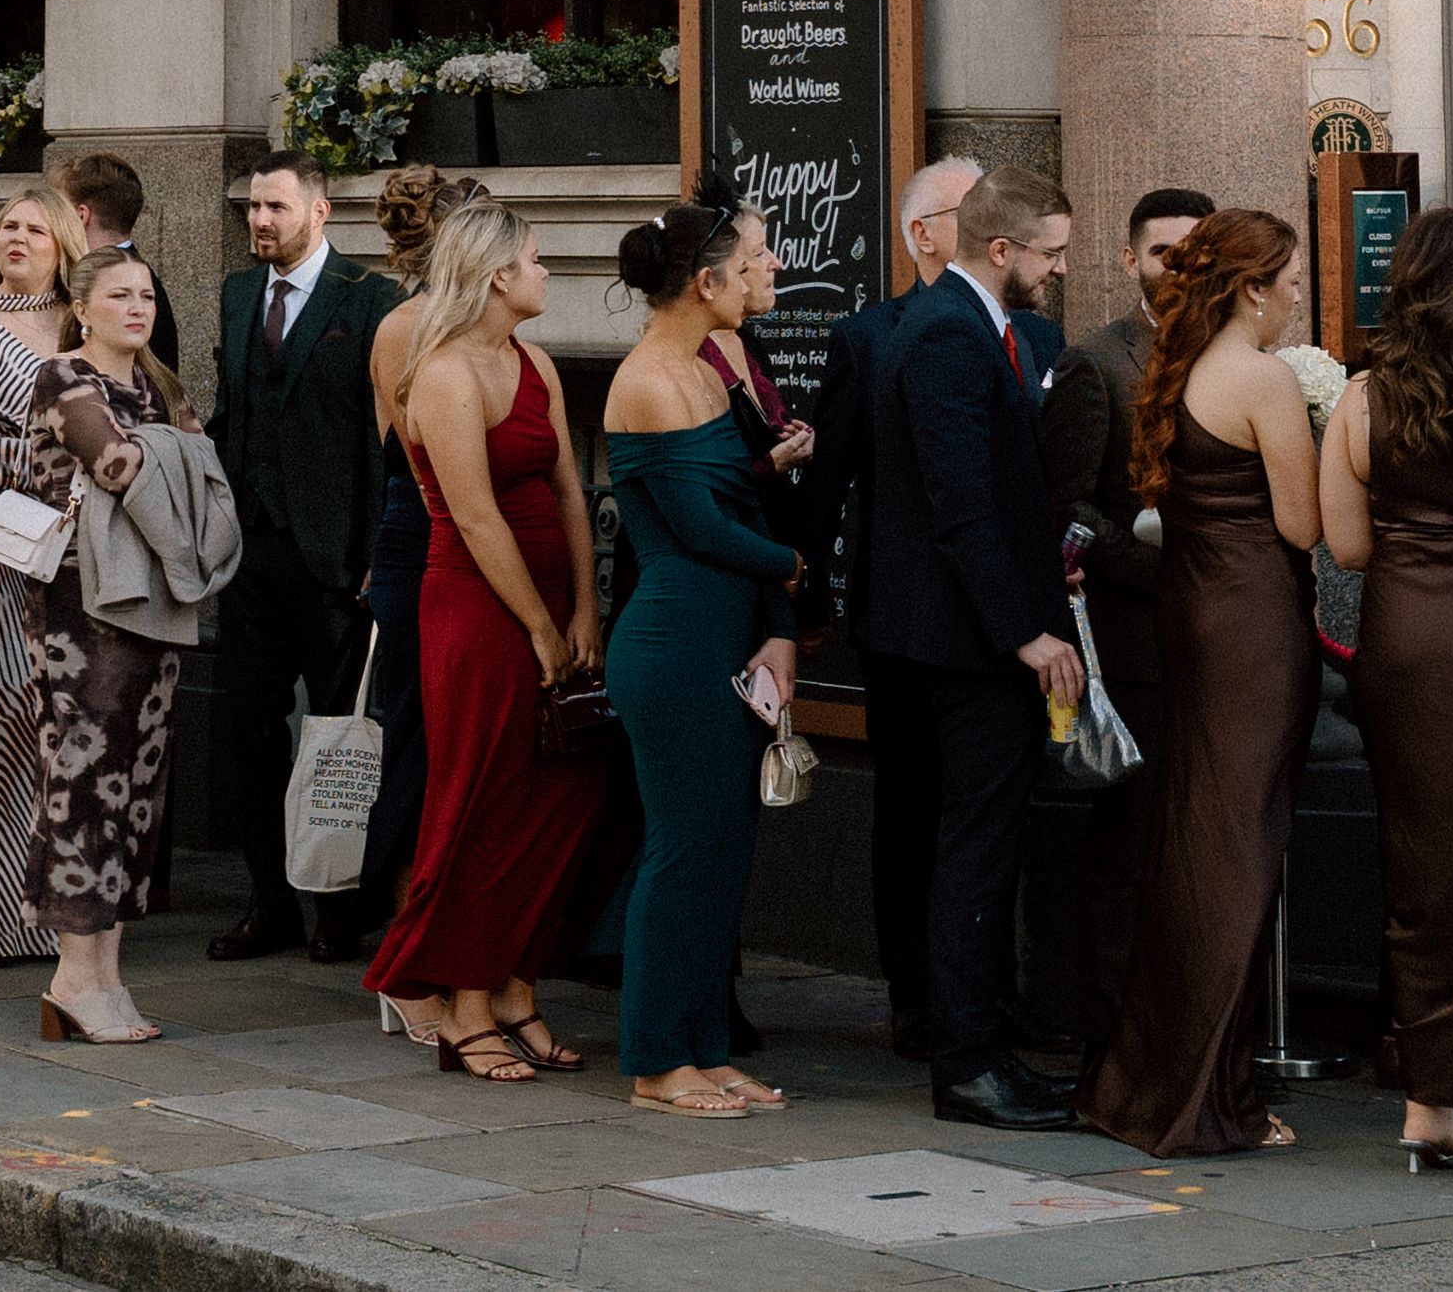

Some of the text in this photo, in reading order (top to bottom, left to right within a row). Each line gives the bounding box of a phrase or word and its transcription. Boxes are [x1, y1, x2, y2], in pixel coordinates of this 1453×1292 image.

[742, 0, 787, 13] Fantastic
[742, 21, 846, 48] Draught Beers
[770, 46, 810, 65] and
[749, 76, 840, 99] World Wines
[1313, 101, 1383, 151] HEATH WINERY
[735, 152, 861, 233] Happy
[755, 325, 779, 337] Please
[781, 327, 793, 337] ask
[797, 351, 807, 365] to
[790, 373, 799, 385] to
[801, 374, 821, 393] 6pm
[317, 749, 333, 757] ALL
[335, 749, 351, 757] OUR
[316, 759, 343, 768] THOSE
[314, 769, 360, 779] HEARTFELT
[313, 779, 355, 789] GESTURES
[311, 789, 343, 799] STOLEN
[311, 800, 329, 809] TELL
[338, 802, 359, 812] PART
[309, 817, 340, 827] SCENTS
[341, 820, 353, 828] OF
